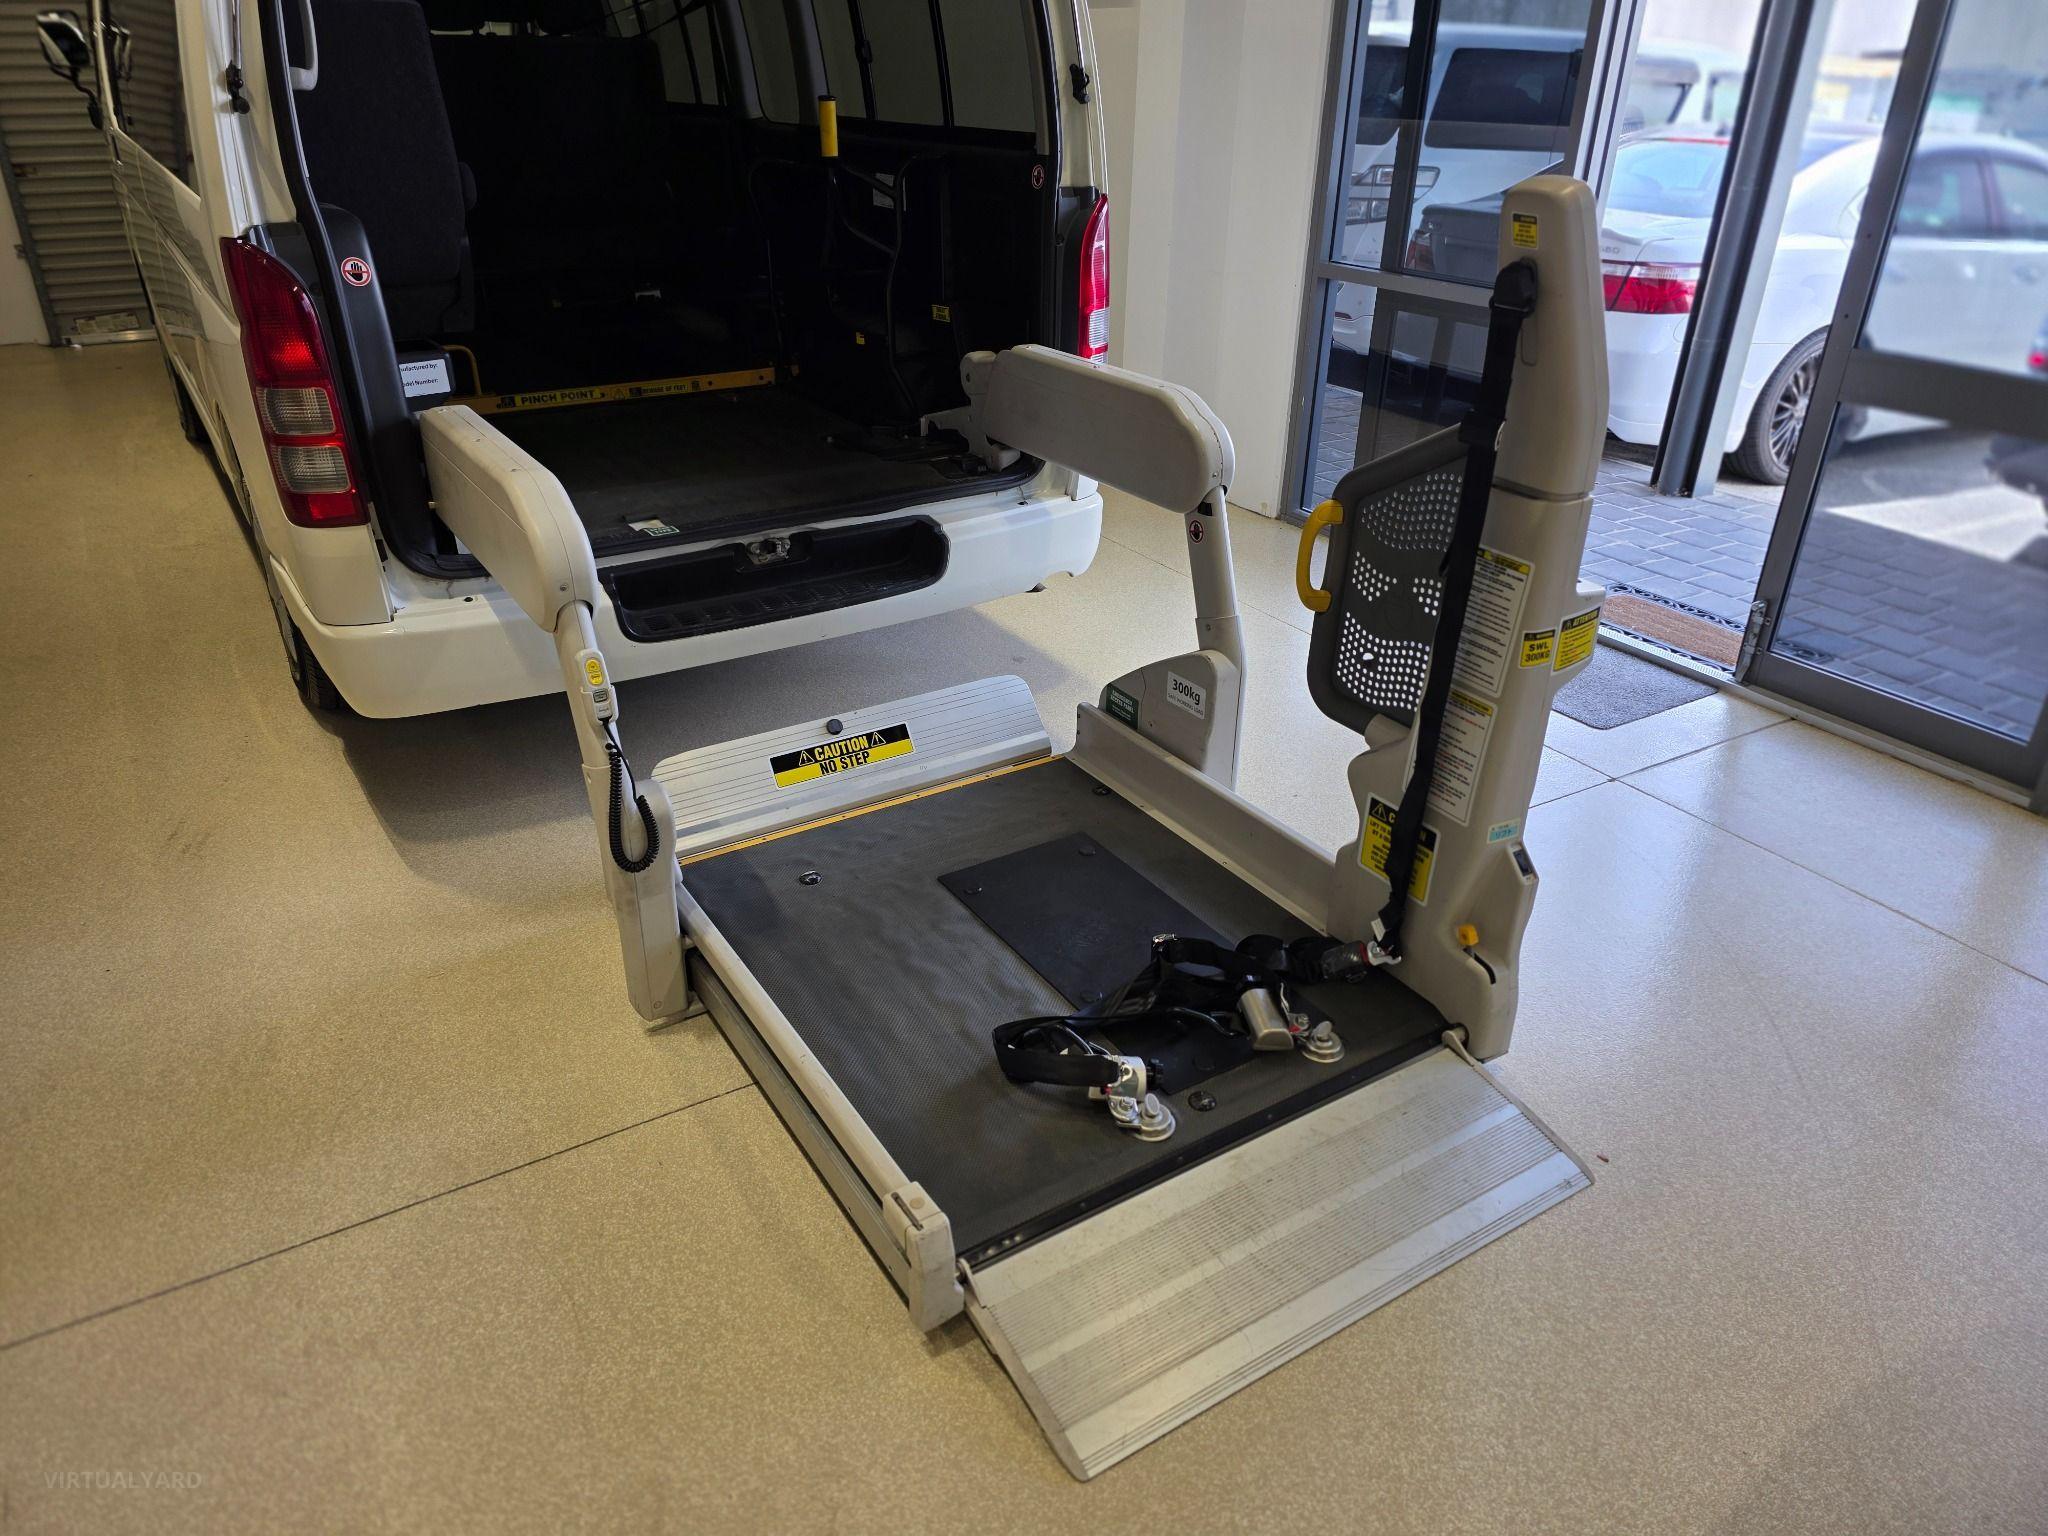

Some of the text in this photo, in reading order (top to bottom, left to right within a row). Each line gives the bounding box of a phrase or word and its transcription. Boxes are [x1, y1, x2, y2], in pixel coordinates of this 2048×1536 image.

[415, 378, 439, 386] Number:
[521, 389, 594, 405] PINCH POINT
[1529, 641, 1549, 652] SWL
[1525, 649, 1551, 663] 300KG
[1172, 679, 1201, 706] 300kg
[814, 735, 869, 761] CAUTION
[819, 750, 870, 775] NO STEP
